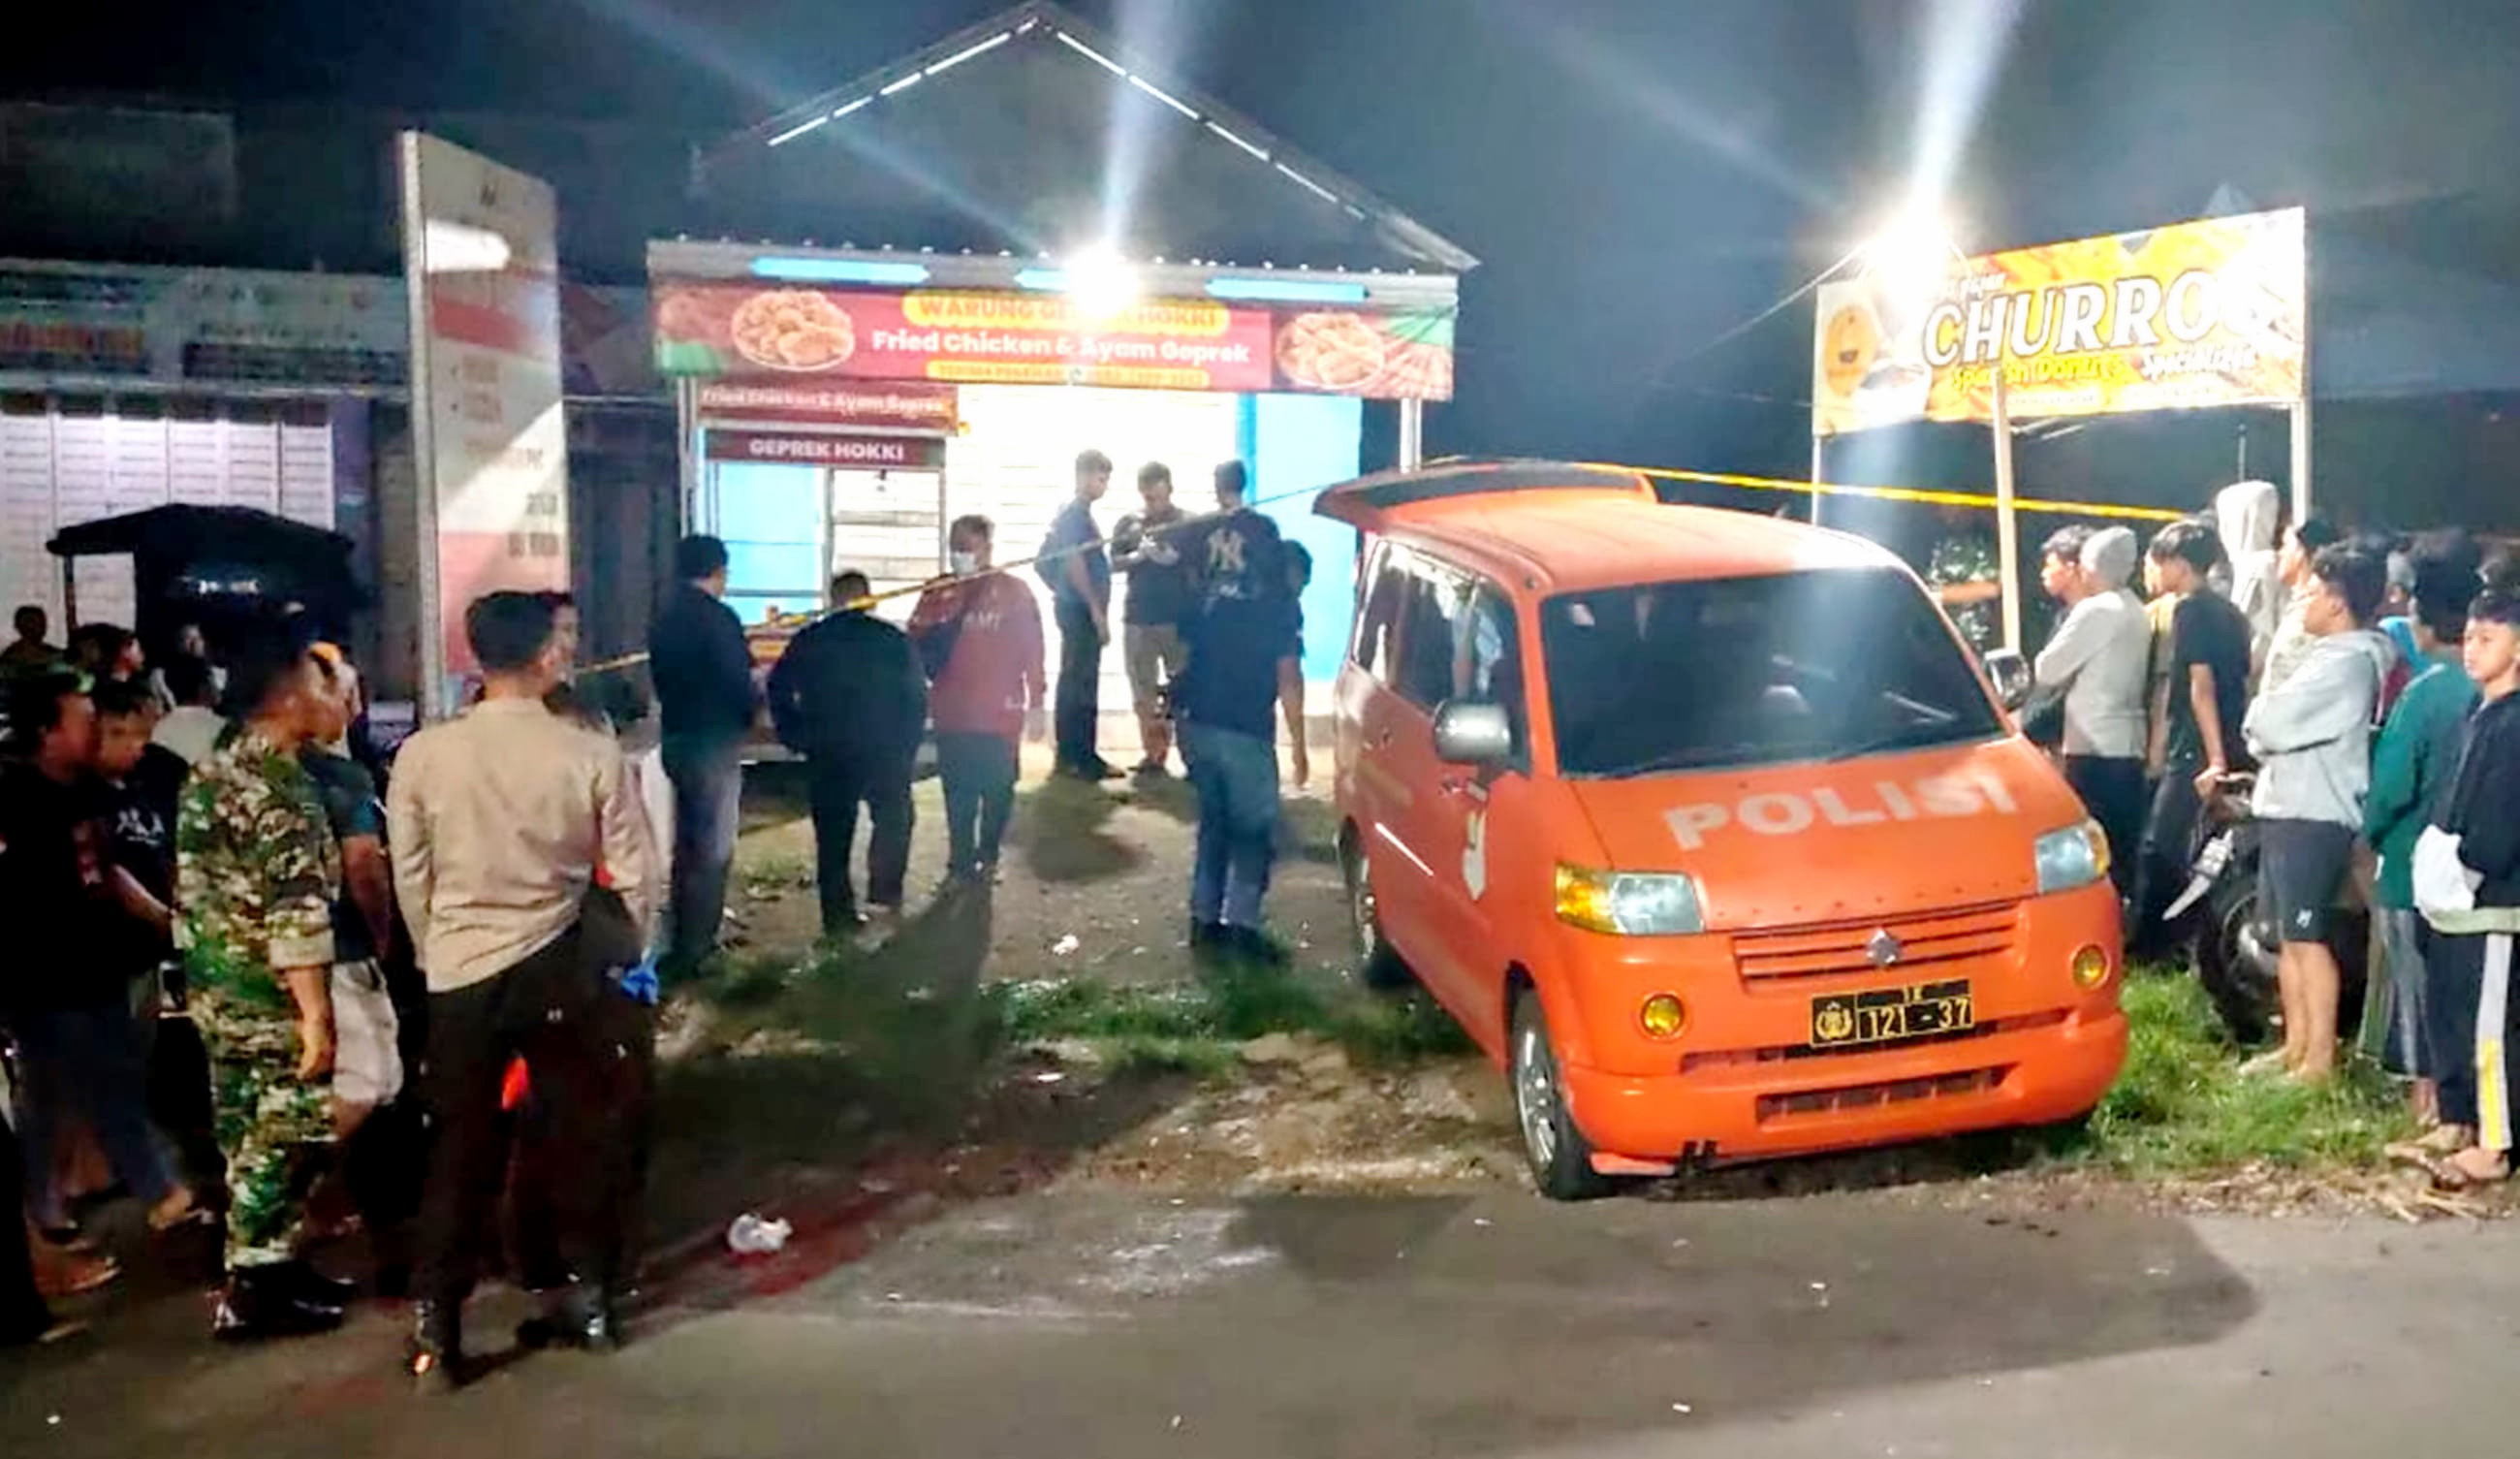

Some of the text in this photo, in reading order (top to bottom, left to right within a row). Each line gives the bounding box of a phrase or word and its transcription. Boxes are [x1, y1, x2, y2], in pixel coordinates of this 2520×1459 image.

[920, 297, 1033, 320] WARUNG
[1924, 264, 2263, 368] CHURRO
[873, 329, 940, 353] Fried
[943, 330, 1051, 355] Chicken
[1080, 338, 1156, 363] Ayam
[1160, 340, 1250, 366] Geprek
[749, 439, 904, 460] GEPREK HOKKI
[1663, 768, 2019, 851] POLISI
